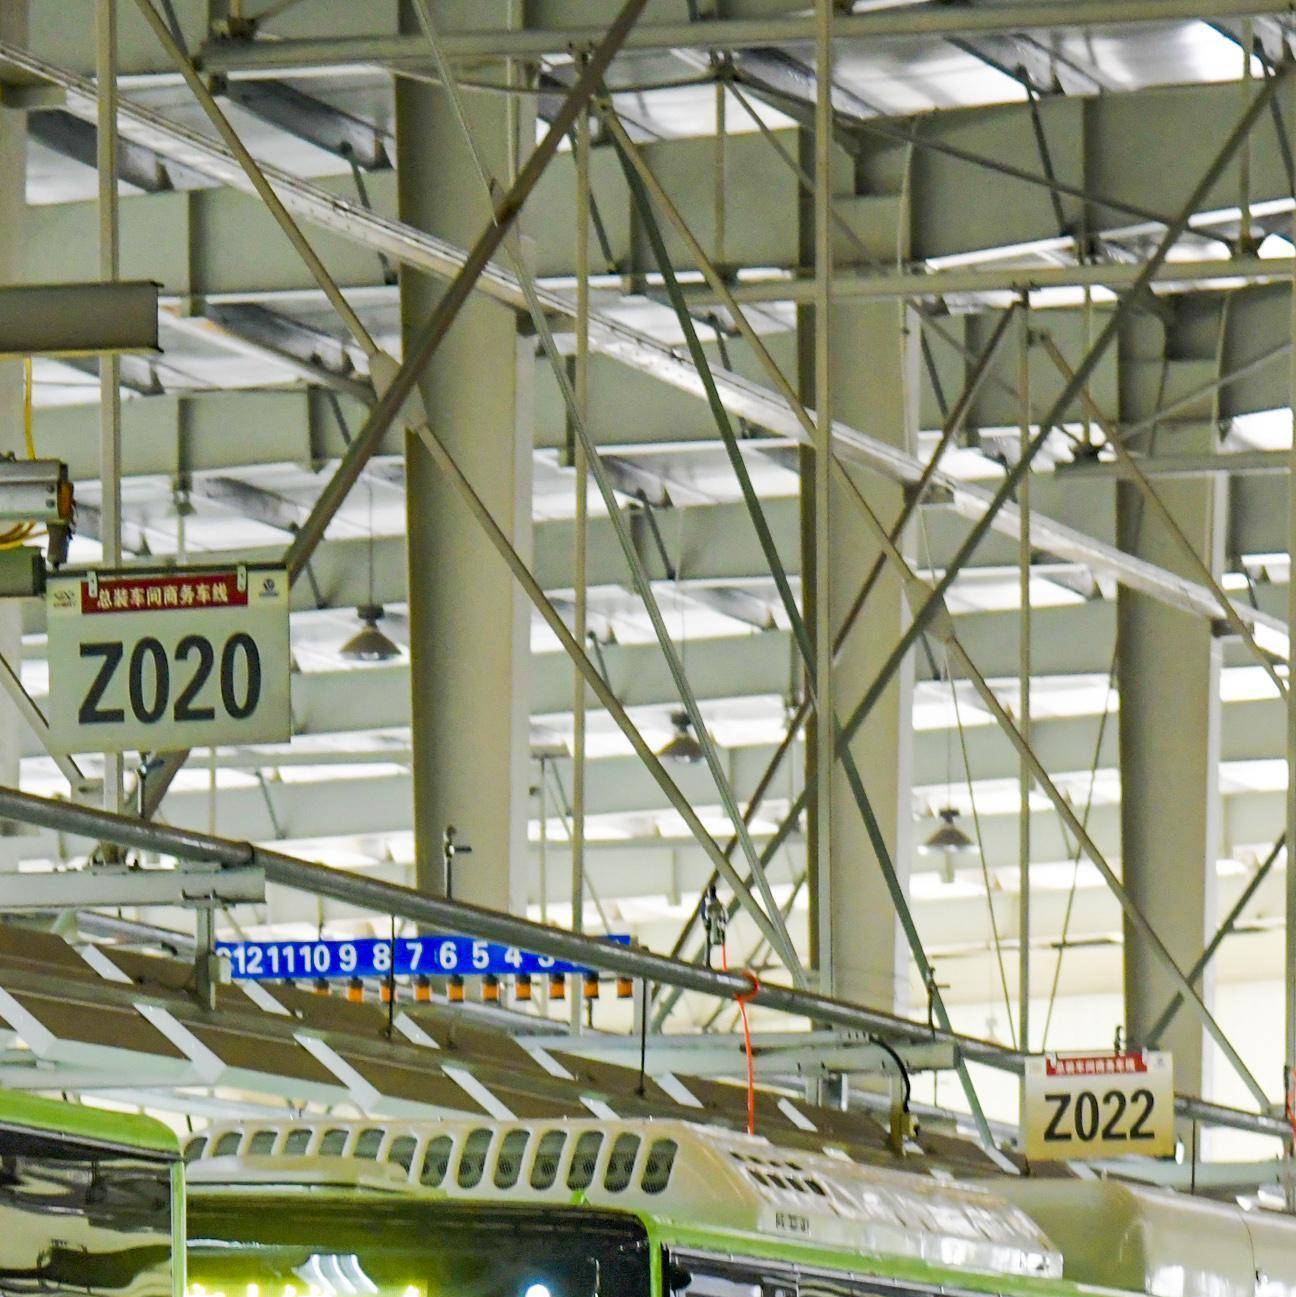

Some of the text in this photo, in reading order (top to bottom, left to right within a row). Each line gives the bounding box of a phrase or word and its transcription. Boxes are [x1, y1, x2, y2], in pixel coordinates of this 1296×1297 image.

[97, 581, 229, 610] 总装车间商务车线
[79, 632, 262, 725] Z020
[234, 943, 263, 974] 12
[267, 945, 295, 973] 11
[300, 944, 330, 972] 10
[339, 943, 357, 971] 9
[373, 942, 391, 971] 8
[406, 941, 423, 971] 7
[439, 941, 457, 969] 6
[472, 940, 490, 969] 5
[504, 947, 522, 968] 4
[1044, 1089, 1155, 1141] Z022
